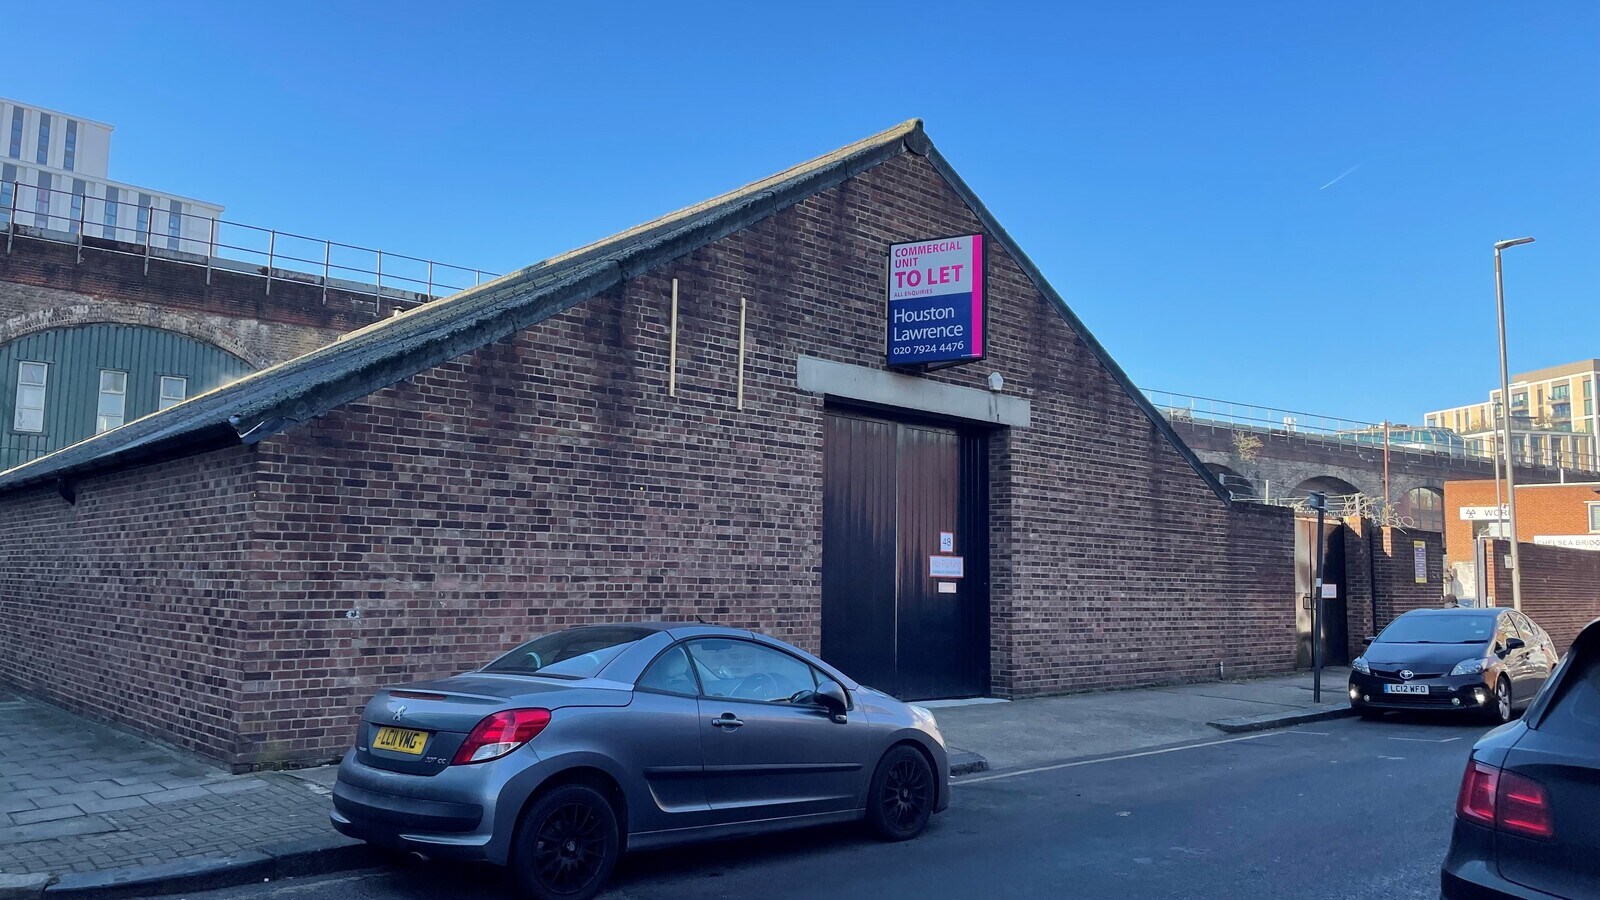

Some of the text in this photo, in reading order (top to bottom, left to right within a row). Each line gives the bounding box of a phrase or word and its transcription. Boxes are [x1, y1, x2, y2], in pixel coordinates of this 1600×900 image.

[895, 241, 962, 257] COMMERCIAL
[895, 257, 919, 269] UNIT
[895, 265, 963, 288] TO LET
[904, 288, 933, 297] ENQUIRIES
[894, 307, 955, 323] Houston
[894, 324, 964, 342] Lawrence
[893, 340, 964, 355] 020 7924 4476
[1484, 509, 1510, 517] WOR
[943, 538, 952, 546] 48
[1390, 685, 1426, 693] LC12 WFO
[381, 729, 419, 748] LC11 VMG
